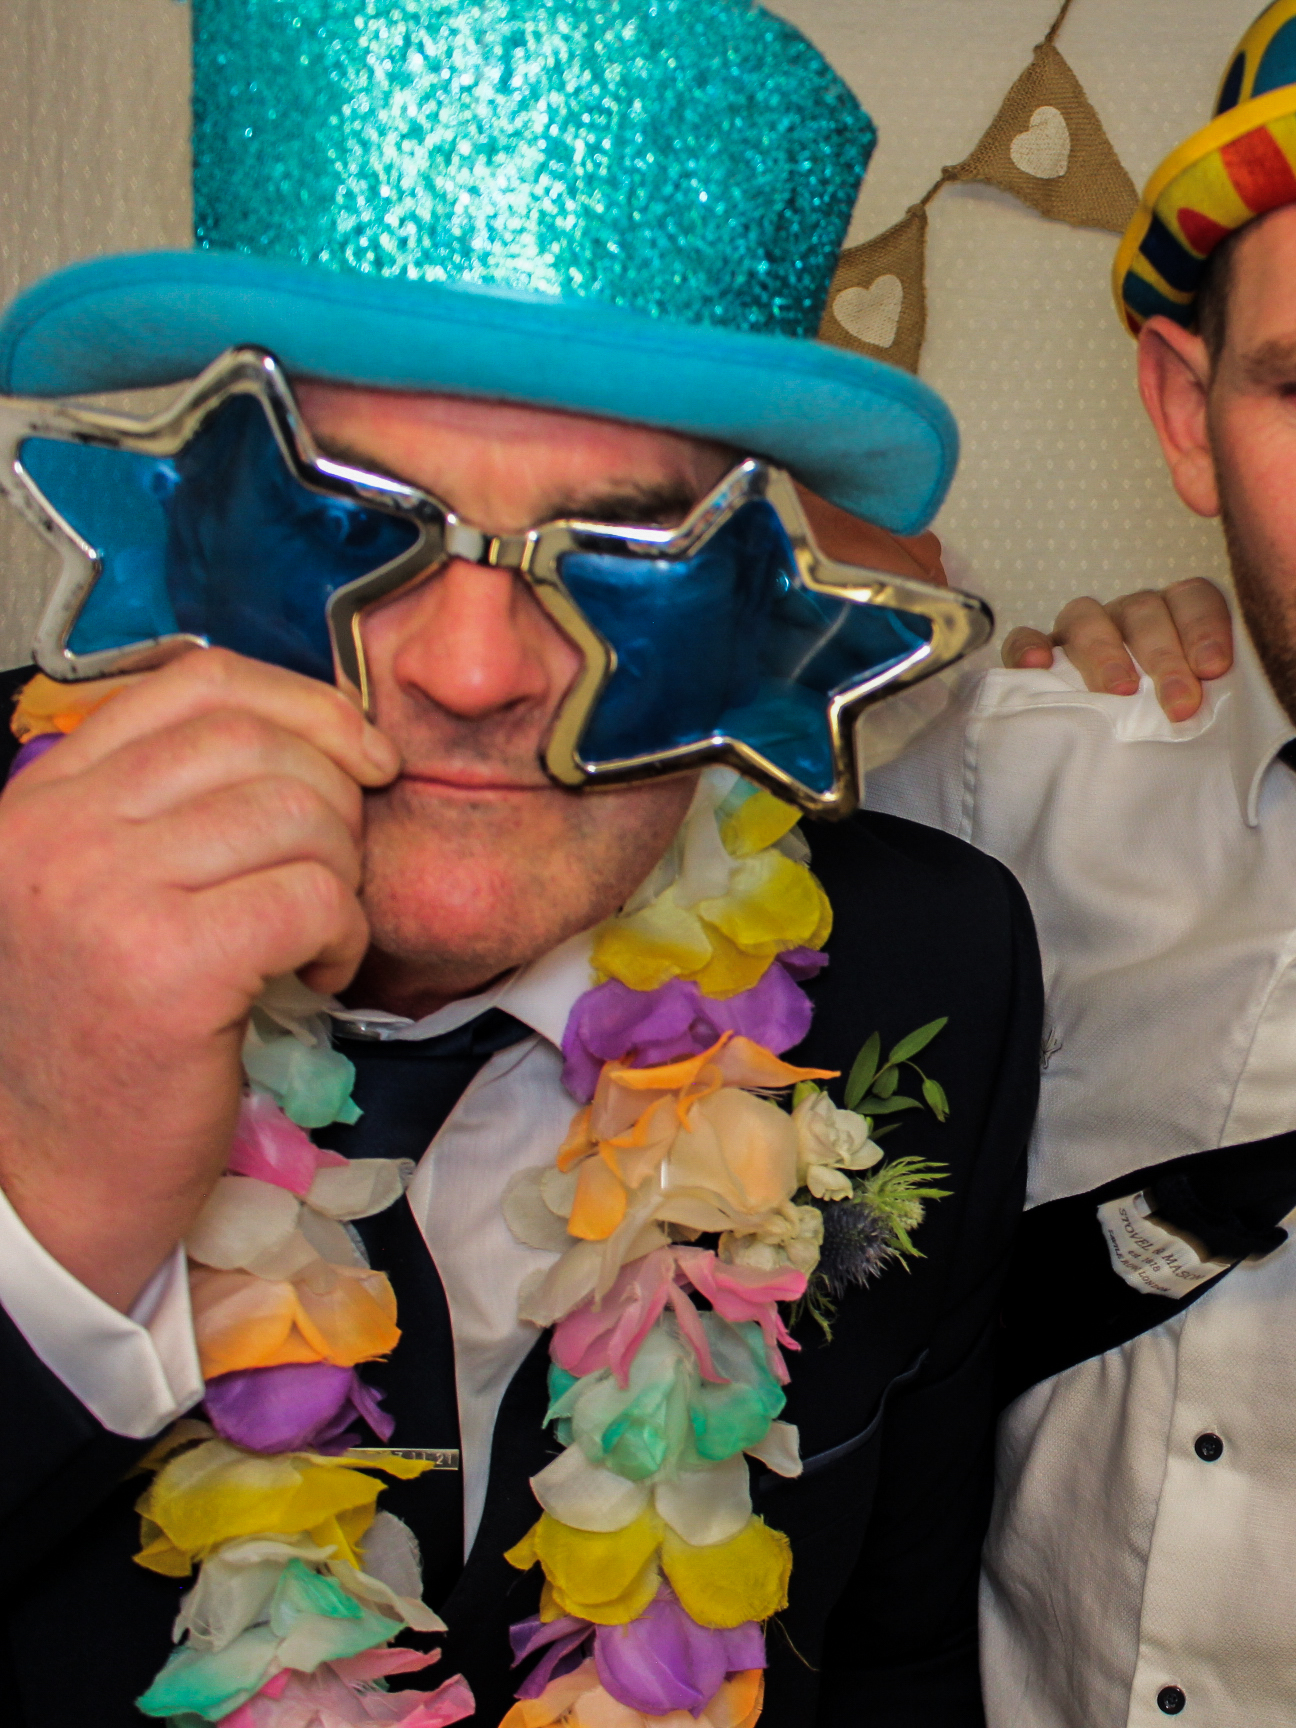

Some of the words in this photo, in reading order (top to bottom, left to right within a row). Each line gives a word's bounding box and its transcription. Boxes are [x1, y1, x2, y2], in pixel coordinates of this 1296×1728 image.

[1119, 1207, 1154, 1252] STOVEL
[1161, 1253, 1205, 1280] MASON
[1138, 1270, 1171, 1292] LONDON
